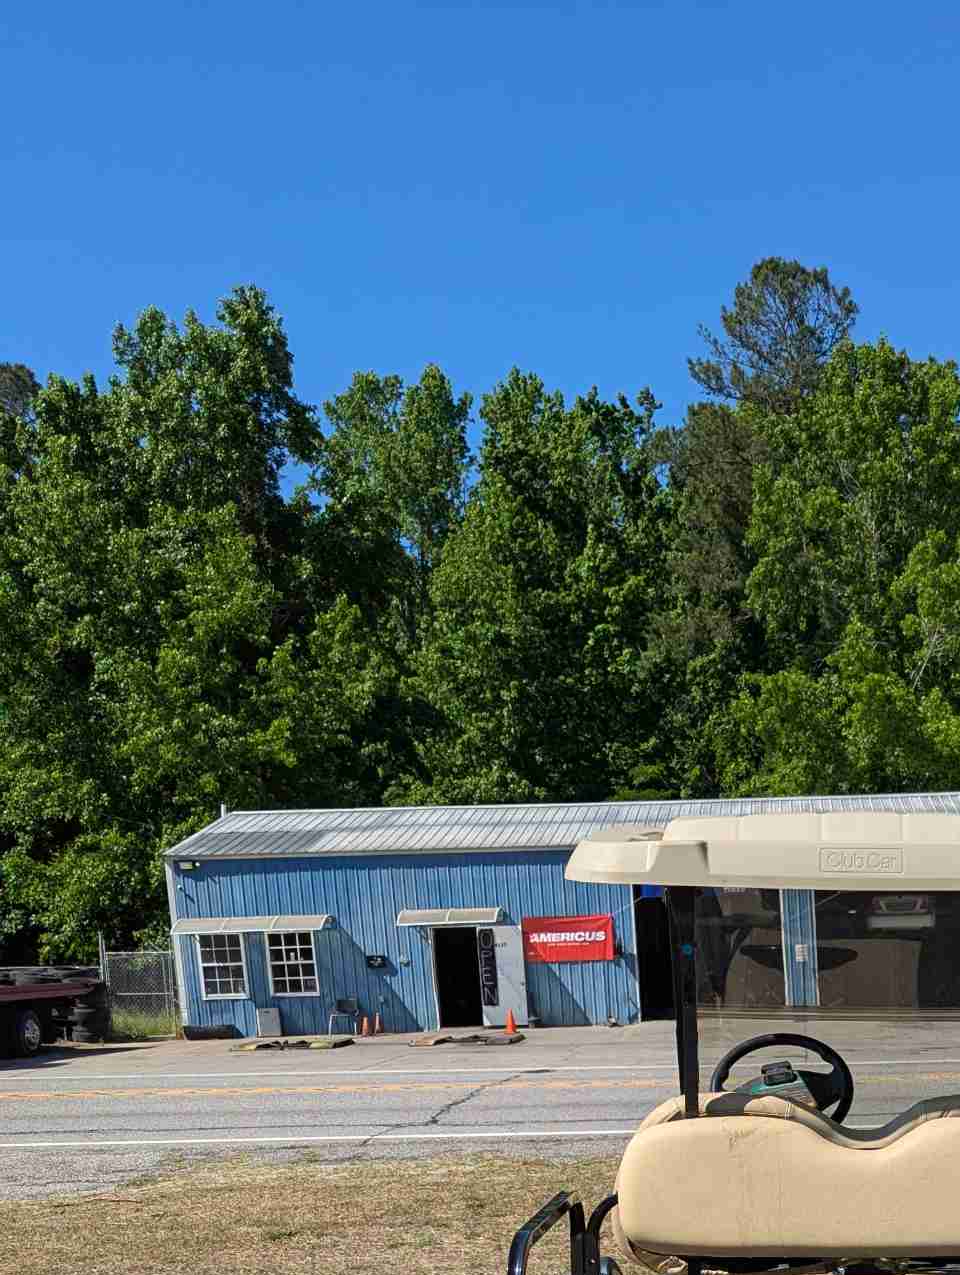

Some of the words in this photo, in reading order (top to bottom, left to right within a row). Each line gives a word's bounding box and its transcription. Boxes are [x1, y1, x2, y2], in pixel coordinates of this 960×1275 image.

[824, 850, 865, 871] Club
[866, 850, 897, 870] Car
[529, 930, 606, 943] AMERICUS
[480, 930, 498, 1005] OPEN
